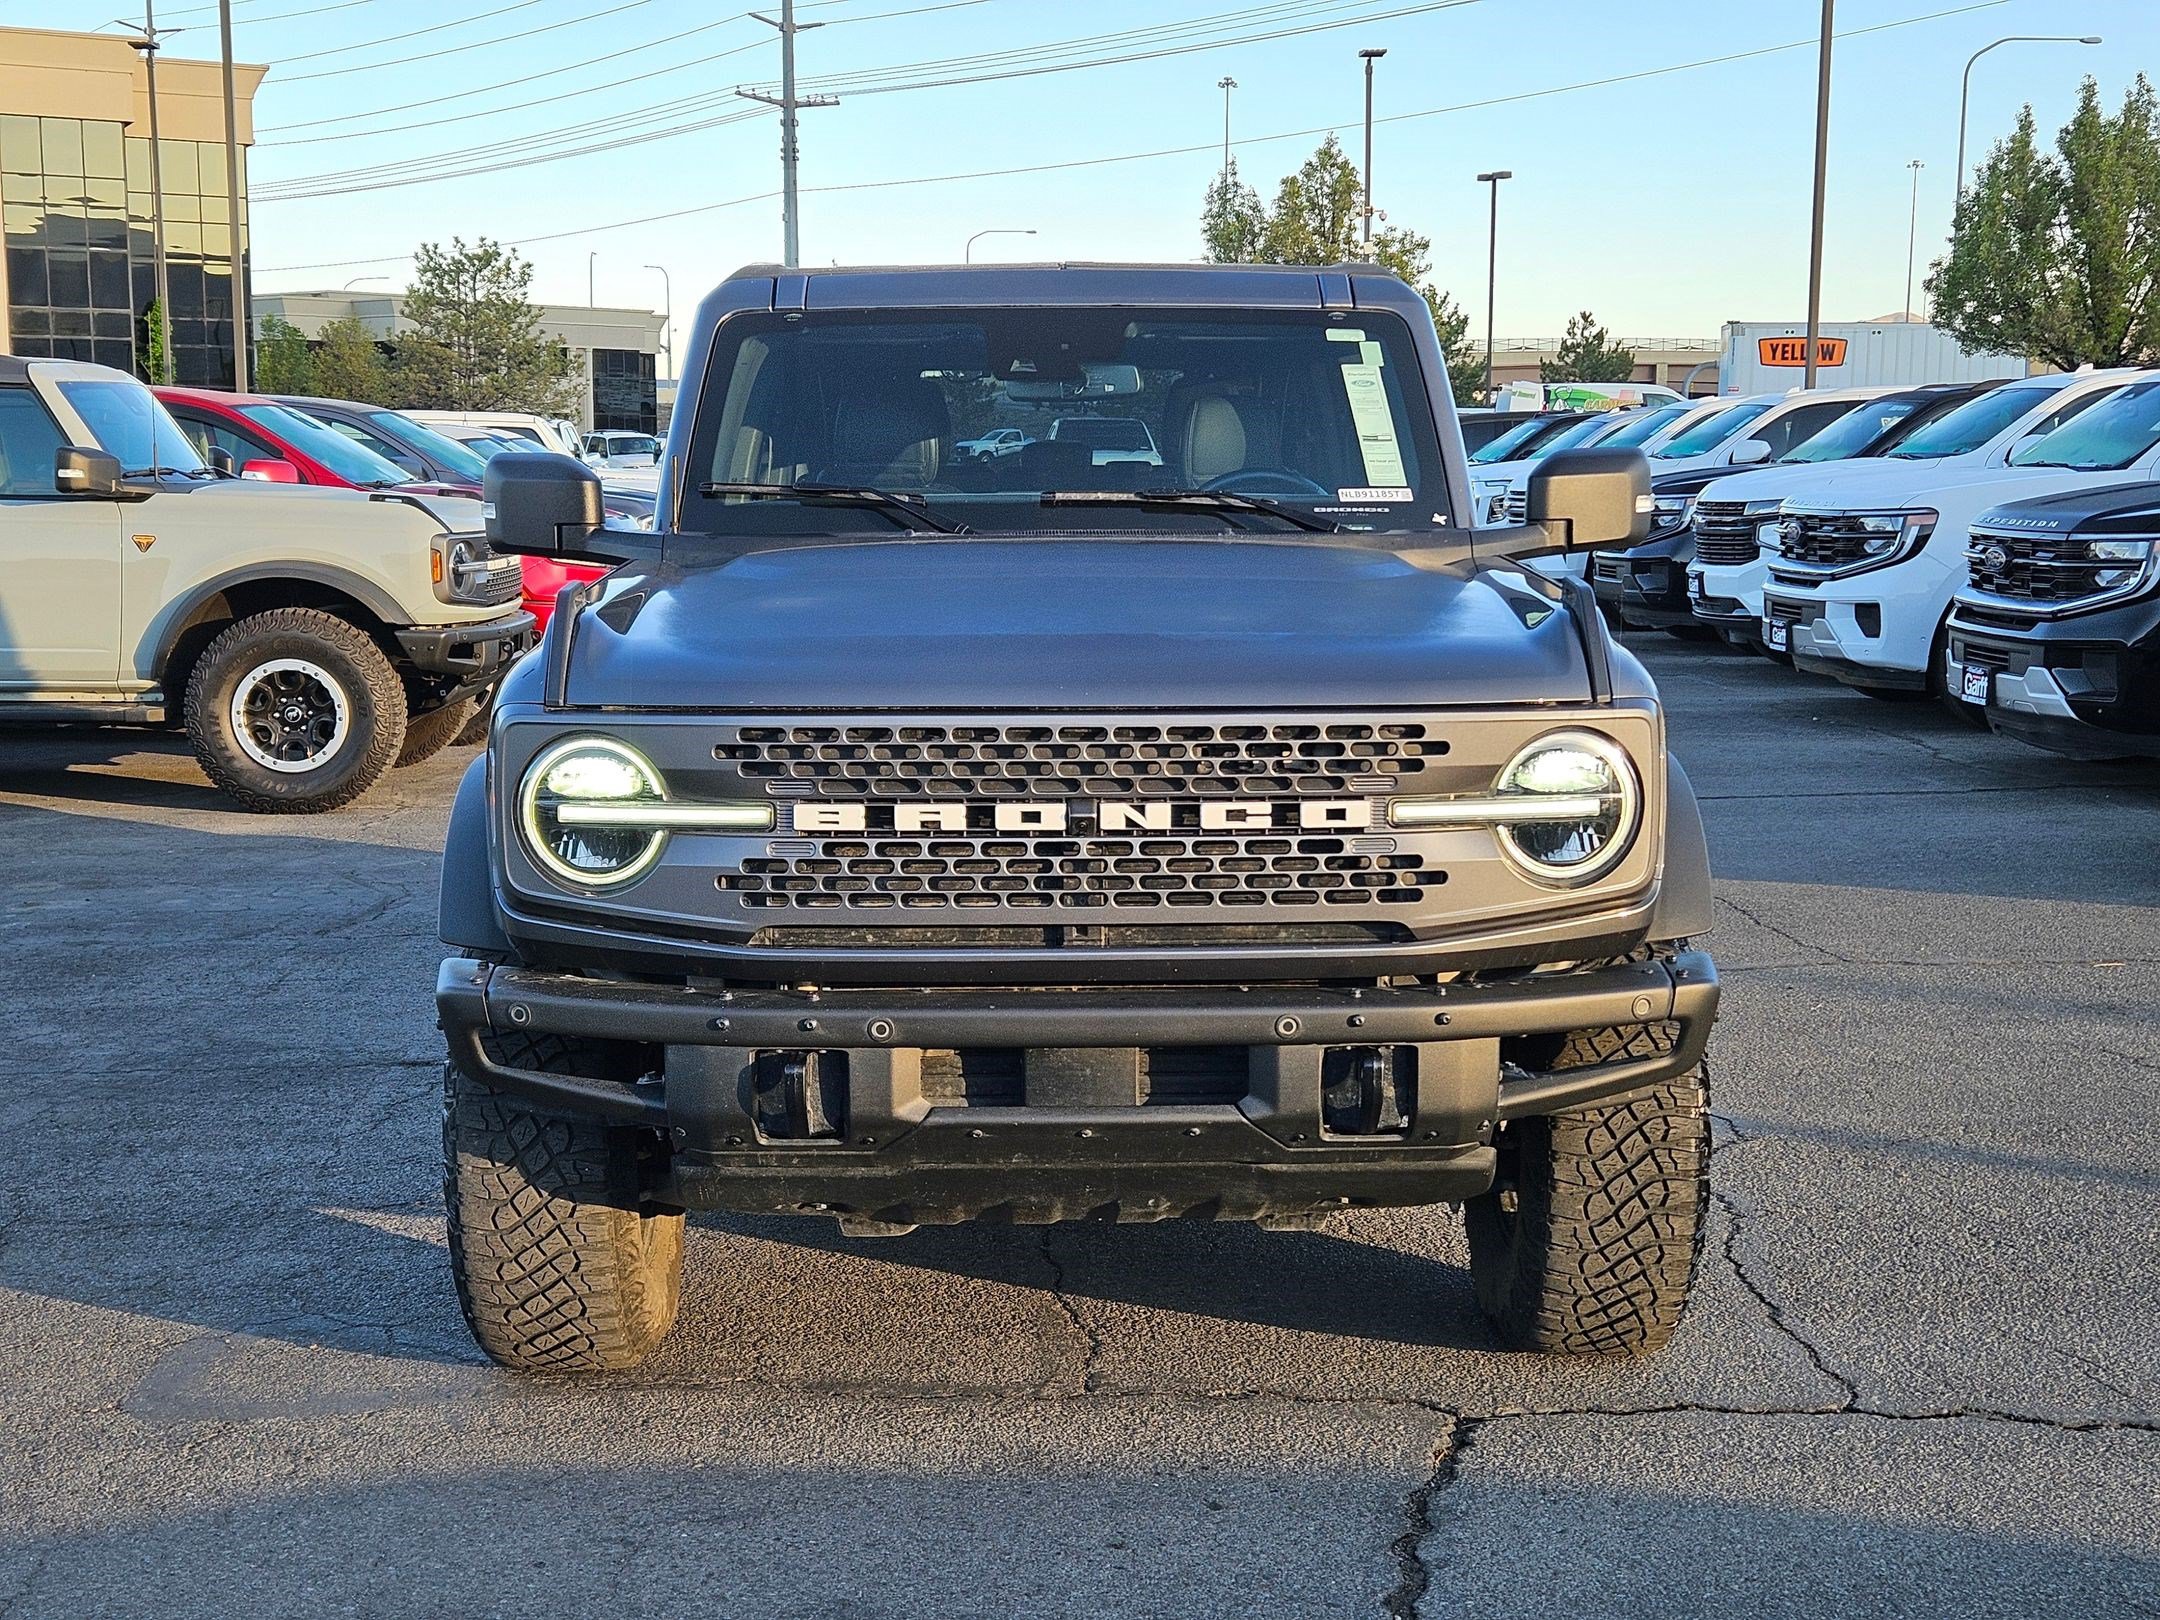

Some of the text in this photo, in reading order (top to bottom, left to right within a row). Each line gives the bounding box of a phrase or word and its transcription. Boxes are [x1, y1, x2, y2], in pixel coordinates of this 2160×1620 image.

[1769, 343, 1836, 361] YELLW
[1979, 516, 2059, 528] EXPEDITION
[794, 803, 1371, 831] BRONCO
